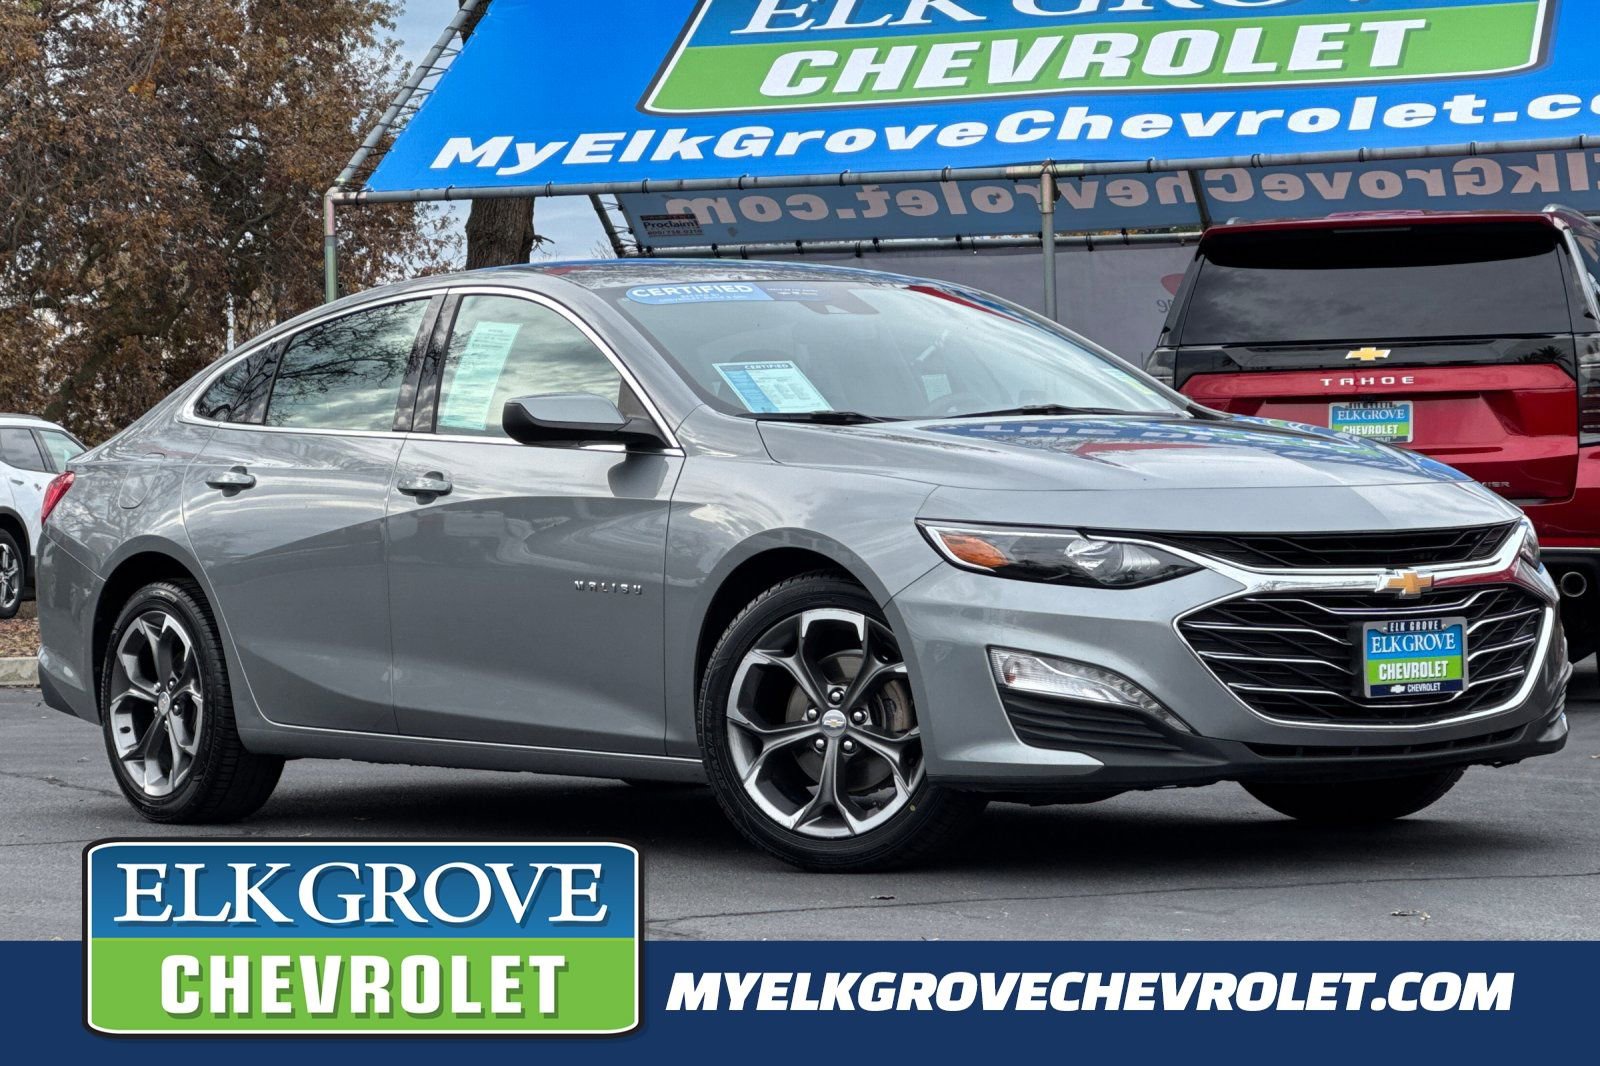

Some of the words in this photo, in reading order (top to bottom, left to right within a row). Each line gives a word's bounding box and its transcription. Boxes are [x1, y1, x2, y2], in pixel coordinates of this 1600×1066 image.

[760, 19, 1427, 97] CHEVROLET
[430, 94, 1600, 176] MyElkGroveChevrolet.c
[631, 284, 754, 298] CERTIFIED
[1320, 376, 1415, 386] TAHOE
[1336, 410, 1361, 421] ELK
[1361, 409, 1405, 420] GROVE
[1342, 424, 1399, 435] CHEVROLET
[574, 580, 643, 595] MALIBU
[1390, 622, 1406, 632] ELK
[1409, 620, 1439, 631] GROVE
[1371, 635, 1401, 653] ELK
[1402, 633, 1456, 652] GROVE
[1379, 660, 1449, 681] CHEVROLET
[1407, 682, 1441, 693] CHEVROLET
